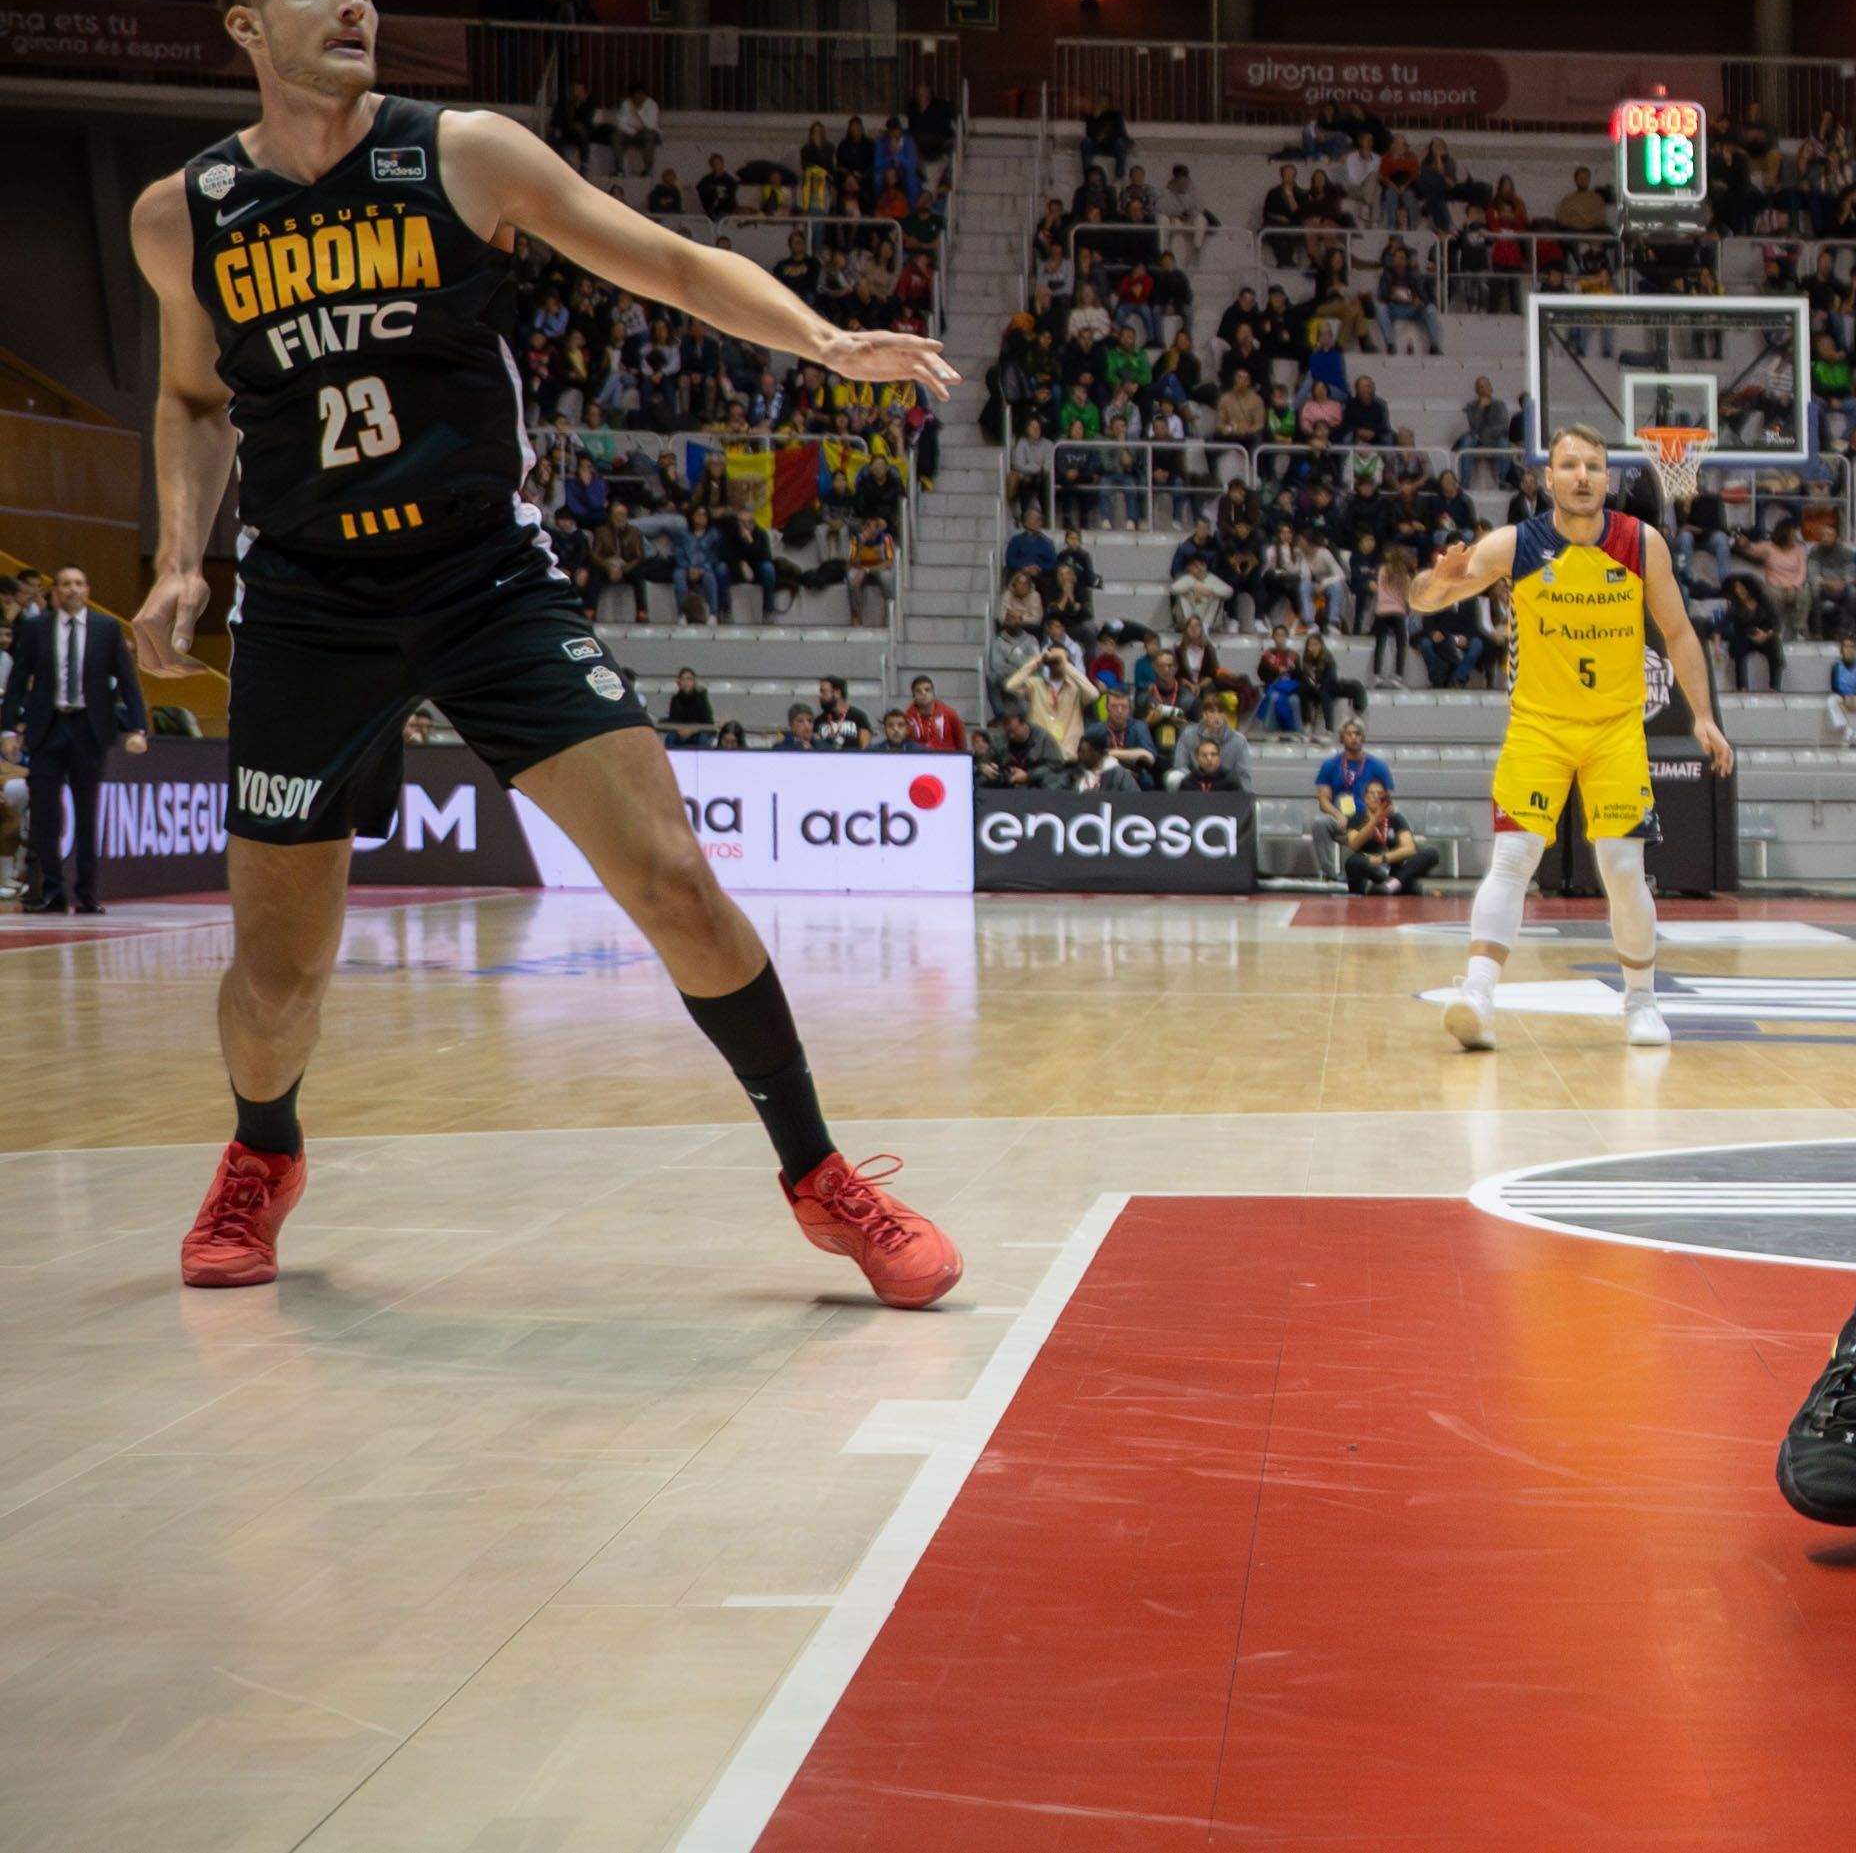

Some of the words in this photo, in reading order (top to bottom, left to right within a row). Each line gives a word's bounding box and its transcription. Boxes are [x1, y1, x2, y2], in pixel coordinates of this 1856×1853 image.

[53, 12, 98, 35] ets
[107, 13, 138, 36] tu
[1247, 56, 1335, 91] girona
[1342, 60, 1384, 84] ets
[1390, 61, 1419, 85] tu
[1305, 84, 1373, 107] girona
[1408, 86, 1478, 109] esport
[1644, 133, 1694, 186] 18
[230, 202, 406, 244] BÀSQUET
[214, 215, 441, 324] GIRONA
[266, 301, 418, 371] FIATC
[319, 376, 401, 470] 23
[1551, 589, 1635, 606] MORABANC
[1560, 624, 1634, 641] Andorra
[1578, 657, 1596, 690] 5
[237, 765, 322, 821] YOSOY
[802, 801, 919, 848] acb
[979, 801, 1239, 859] endesa
